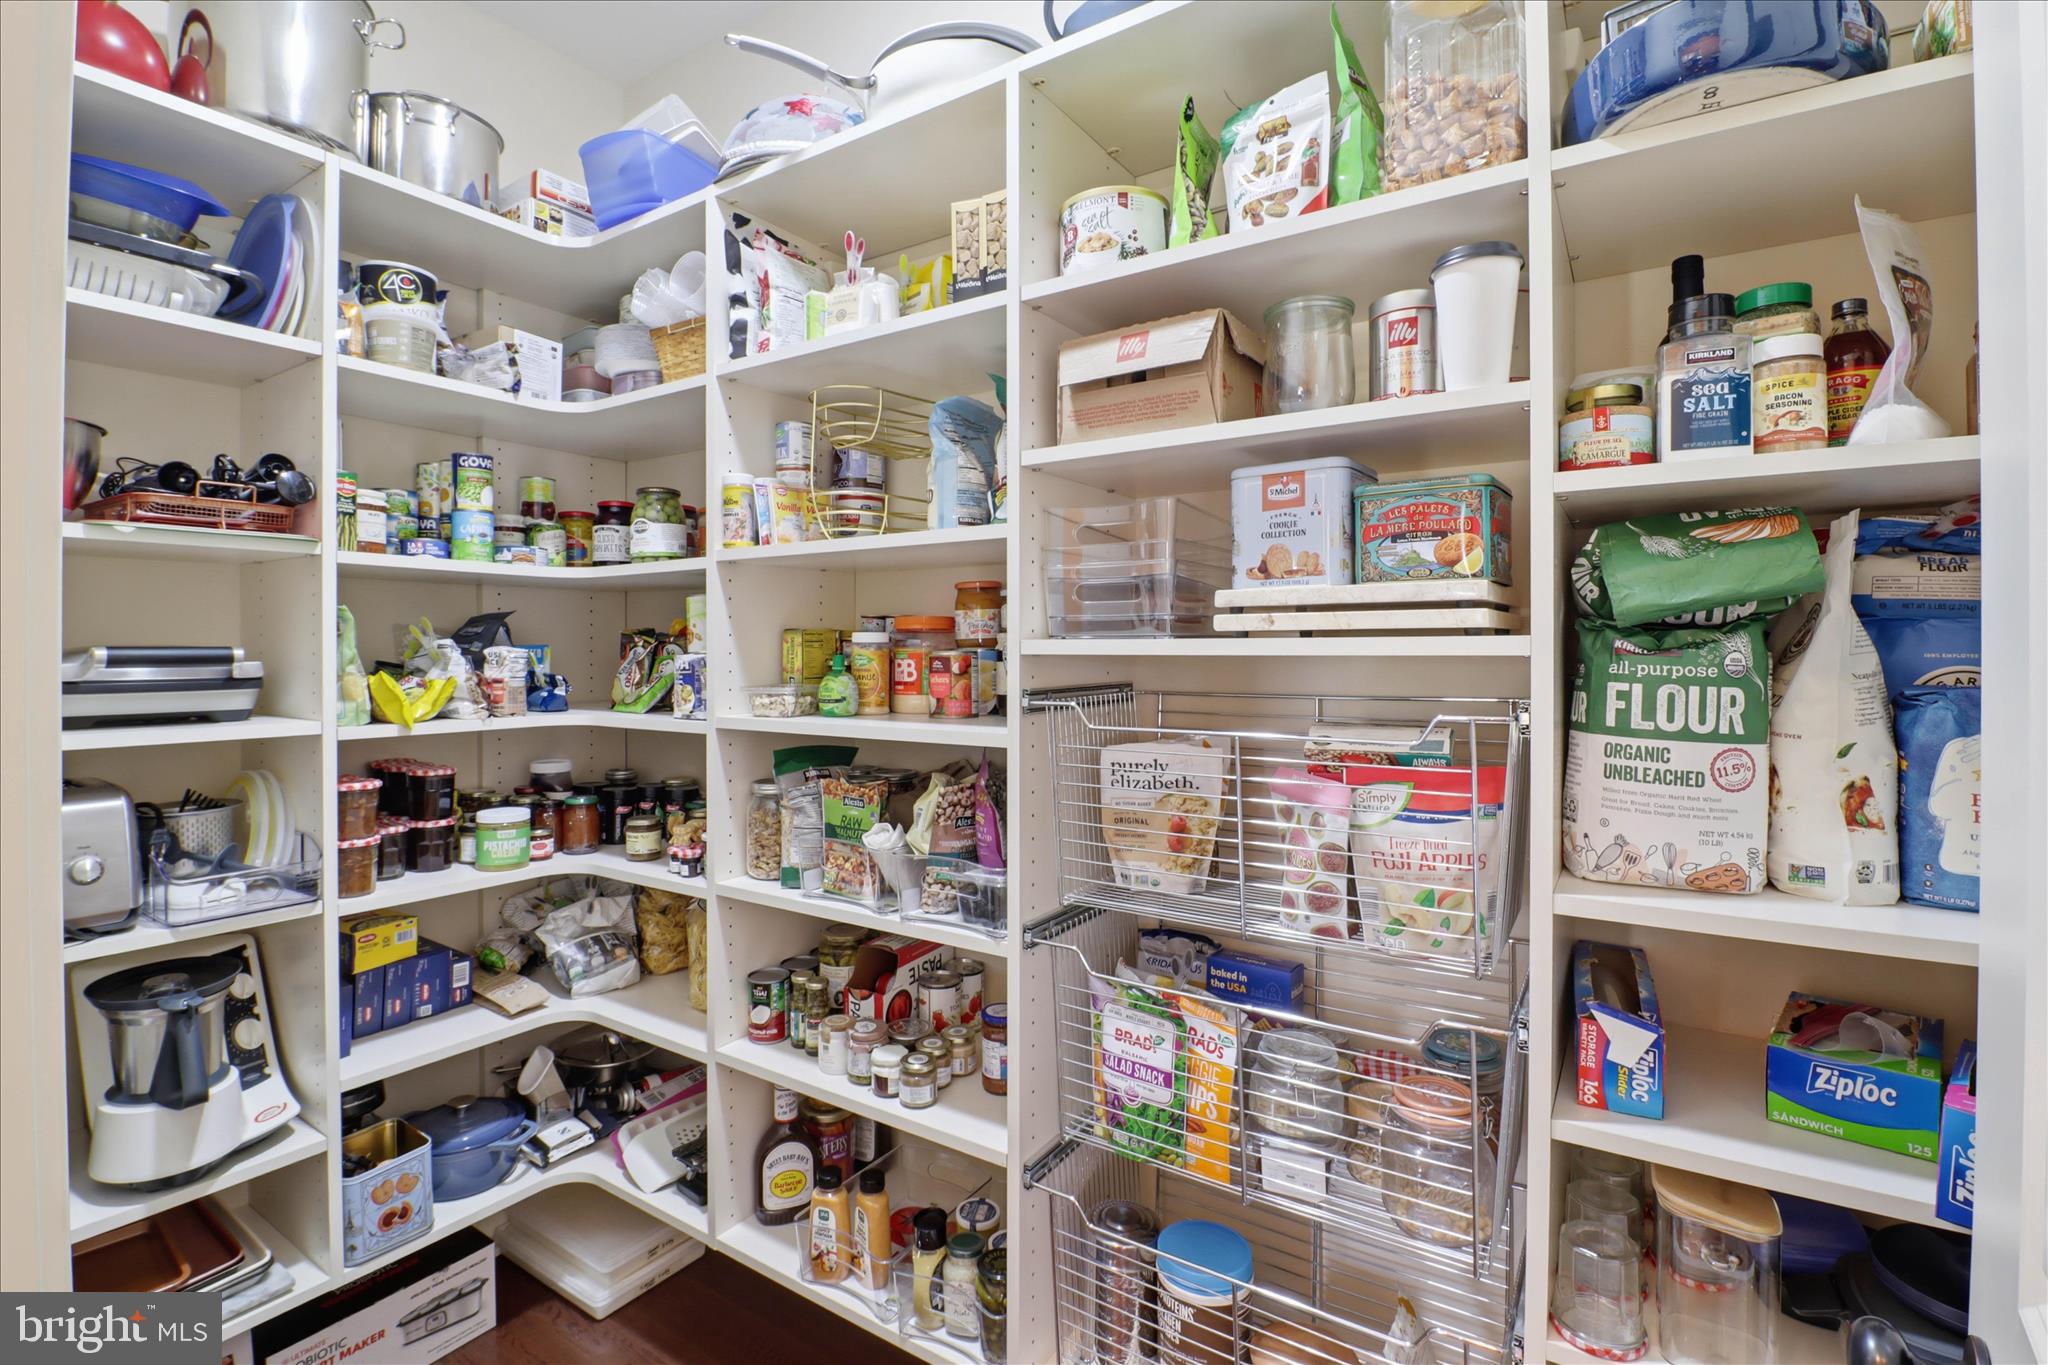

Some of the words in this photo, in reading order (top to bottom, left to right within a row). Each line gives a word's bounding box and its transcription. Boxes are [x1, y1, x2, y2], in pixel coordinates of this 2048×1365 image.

[1389, 321, 1417, 345] illy
[1120, 335, 1147, 357] illy
[1688, 348, 1734, 360] KIRKLAND
[1691, 381, 1730, 396] sea
[1765, 381, 1794, 391] SPICE
[1683, 394, 1737, 413] SALT
[1774, 392, 1804, 401] BACON
[1765, 399, 1813, 411] SEASONING
[1692, 411, 1707, 419] FINE
[1708, 410, 1729, 418] GRAIN
[1580, 450, 1626, 461] CAMARGUE
[1274, 486, 1298, 497] Michel
[1388, 505, 1408, 519] LES
[1409, 504, 1450, 515] PALETS
[1269, 520, 1299, 530] COOKIE
[1370, 526, 1384, 538] LA
[1418, 519, 1472, 531] POULARD
[1260, 528, 1307, 540] COLLECTION
[1608, 661, 1718, 679] all-purpose
[1605, 681, 1746, 735] FLOUR
[1604, 741, 1672, 764] ORGANIC
[1110, 758, 1169, 778] purely
[1412, 757, 1447, 767] ALWAYS
[1603, 763, 1706, 789] UNBLEACHED
[1716, 762, 1751, 778] 11.5%
[1110, 774, 1200, 791] elizabeth.
[843, 798, 864, 808] Alesto
[1358, 790, 1397, 804] Simply
[1639, 791, 1667, 800] Organic
[1653, 809, 1677, 818] Dough
[840, 815, 863, 828] RAW
[1114, 817, 1150, 826] ORIGINAL
[1699, 830, 1715, 838] NET
[1717, 831, 1729, 839] WT
[1389, 836, 1421, 850] Freeze
[1423, 836, 1448, 850] Dried
[1699, 839, 1710, 847] (10
[1371, 850, 1412, 871] FUJI
[1418, 851, 1487, 872] APPLES
[1210, 967, 1237, 979] baked
[1239, 971, 1248, 982] in
[1210, 978, 1225, 988] the
[1227, 983, 1247, 994] USA
[1188, 1026, 1224, 1060] RADS
[1586, 1024, 1597, 1069] STORAGE
[1105, 1054, 1133, 1075] SALAD
[1134, 1063, 1165, 1087] SNACK
[1617, 1066, 1629, 1099] Slider
[1814, 1066, 1898, 1107] Ziploc
[1583, 1079, 1599, 1105] 166
[1772, 1110, 1844, 1137] SANDWICH
[1906, 1142, 1933, 1157] 125
[295, 1336, 348, 1365] OBIOTIC
[339, 1328, 386, 1361] MAKER
